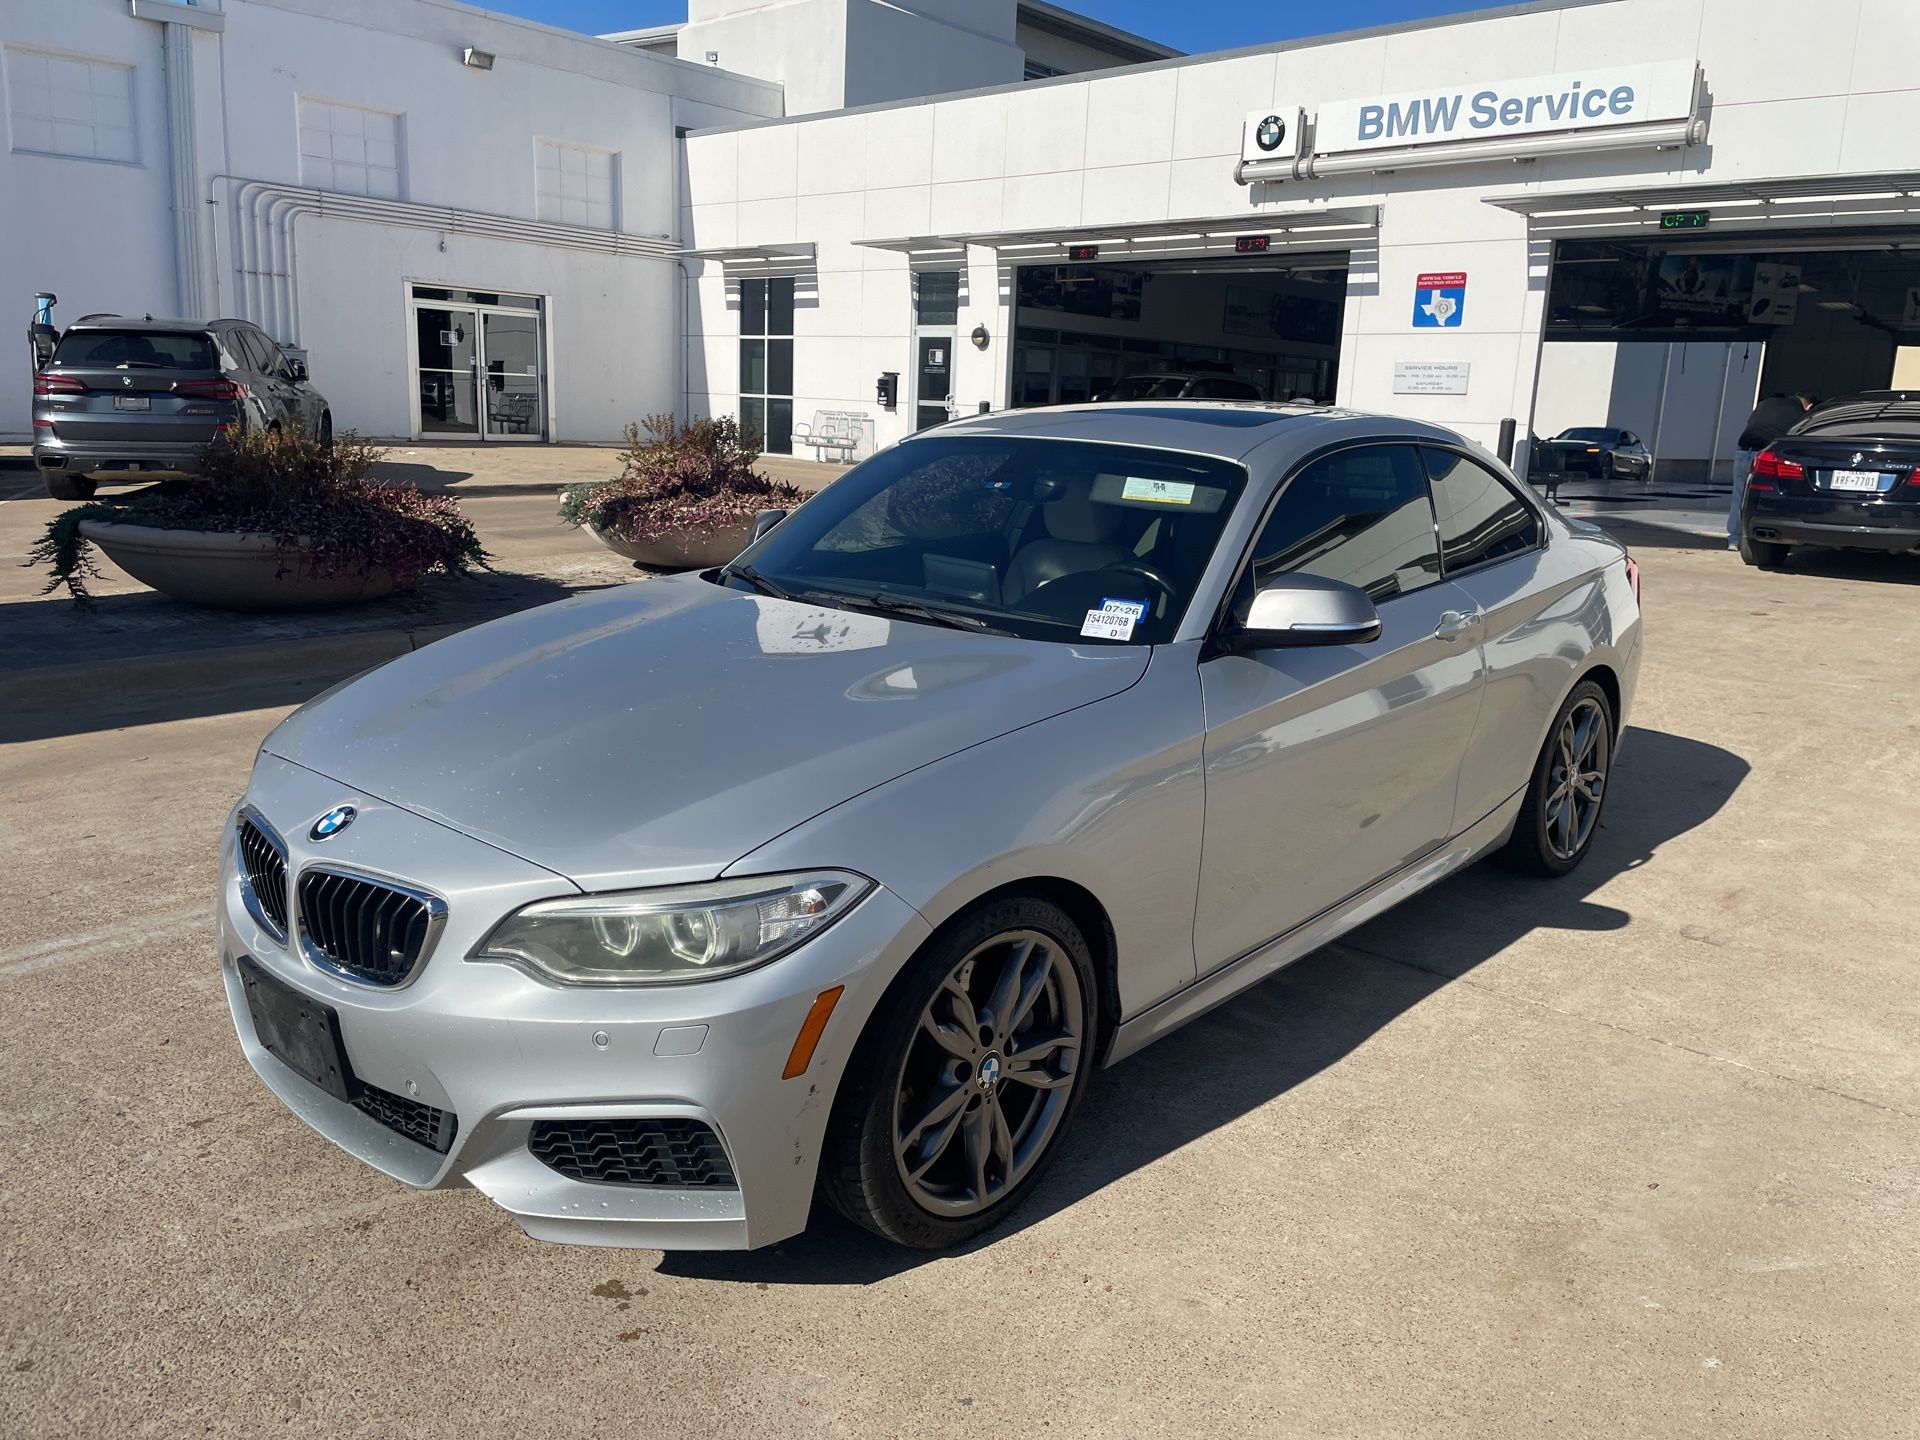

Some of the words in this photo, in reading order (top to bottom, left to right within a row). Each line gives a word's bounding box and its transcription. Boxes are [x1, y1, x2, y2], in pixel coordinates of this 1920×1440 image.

[1357, 94, 1463, 141] BMW
[1469, 81, 1635, 129] Service
[1110, 629, 1118, 637] D
